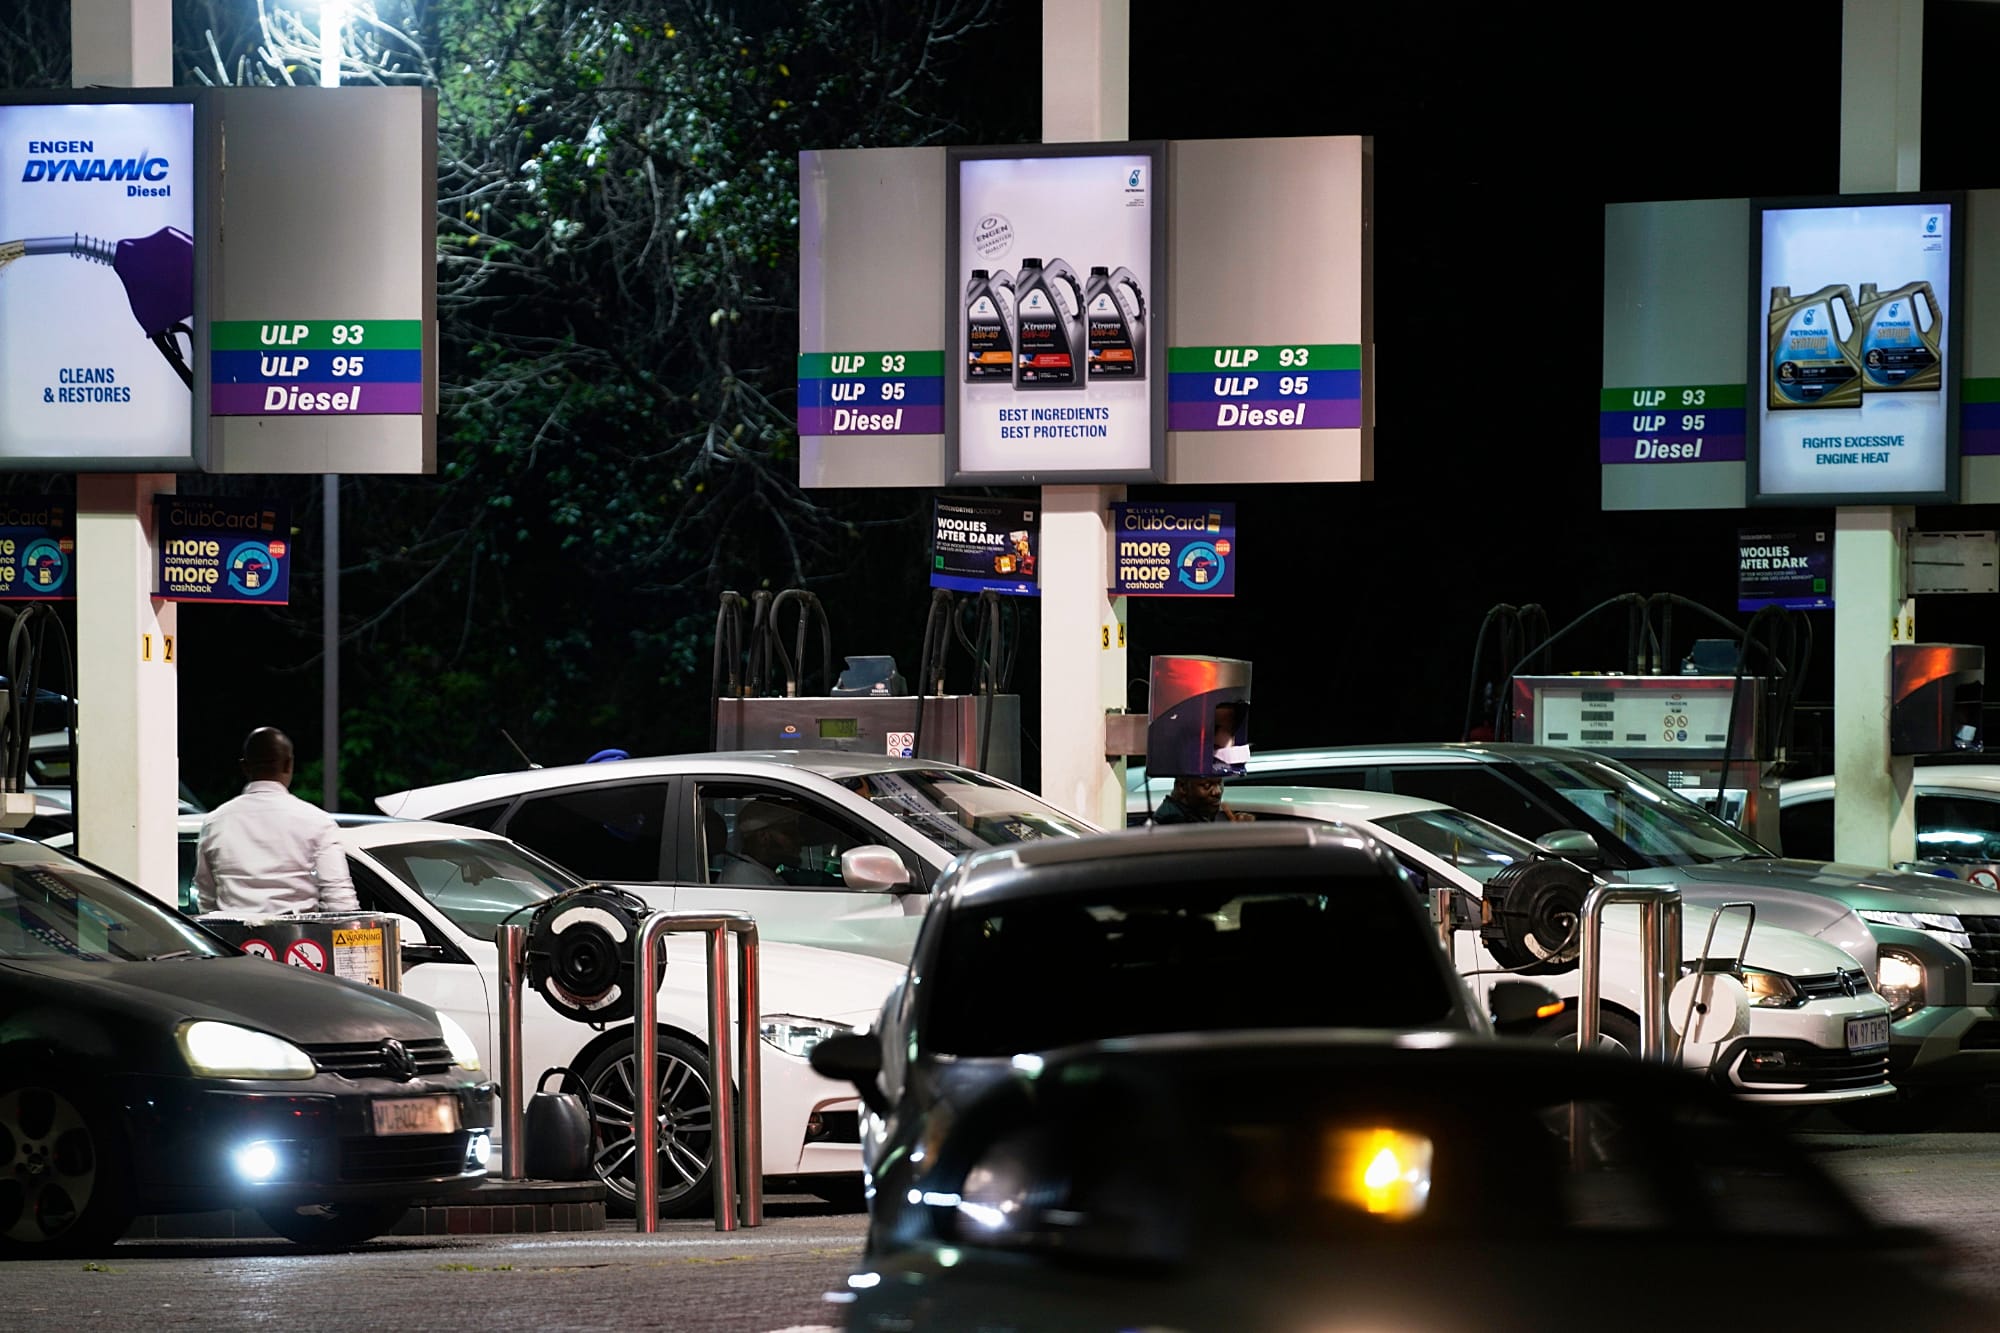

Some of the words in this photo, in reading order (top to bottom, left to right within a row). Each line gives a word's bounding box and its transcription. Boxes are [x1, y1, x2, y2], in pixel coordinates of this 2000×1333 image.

[29, 141, 93, 153] ENGEN
[22, 156, 170, 183] DYNAMIC
[127, 185, 171, 197] Diesel
[976, 224, 1008, 242] ENGEN
[972, 324, 1001, 332] Xtreme
[1022, 322, 1057, 331] Xtreme
[1091, 322, 1121, 331] Xtreme
[260, 325, 309, 346] ULP
[332, 325, 364, 345] 93
[831, 356, 865, 374] ULP
[881, 355, 905, 372] 93
[1214, 349, 1259, 368] ULP
[1279, 348, 1309, 367] 93
[260, 357, 309, 378] ULP
[331, 357, 364, 377] 95
[60, 368, 115, 384] CLEANS
[831, 383, 865, 401] ULP
[881, 383, 905, 400] 95
[1214, 377, 1259, 396] ULP
[1279, 377, 1309, 395] 95
[43, 388, 55, 402] &
[58, 388, 131, 402] RESTORES
[264, 386, 361, 411] Diesel
[1633, 390, 1666, 407] ULP
[1682, 389, 1706, 406] 93
[833, 409, 903, 431] Diesel
[999, 409, 1028, 422] BEST
[1032, 407, 1109, 421] INGREDIENTS
[1217, 403, 1306, 427] Diesel
[1632, 415, 1666, 432] ULP
[1681, 415, 1705, 431] 95
[1001, 426, 1030, 439] BEST
[1034, 425, 1107, 438] PROTECTION
[1634, 438, 1703, 459] Diesel
[1802, 436, 1842, 448] FIGHTS
[1844, 435, 1905, 447] EXCESSIVE
[1816, 453, 1859, 465] ENGINE
[1861, 452, 1890, 463] HEAT
[170, 509, 258, 528] ClubCard
[937, 517, 987, 533] WOOLIES
[1124, 515, 1205, 531] ClubCard
[936, 529, 966, 543] AFTER
[969, 532, 1005, 546] DARK
[165, 540, 219, 557] more
[1120, 542, 1171, 557] more
[1740, 546, 1790, 558] WOOLIES
[165, 557, 219, 565] convenience
[1120, 557, 1170, 565] convenience
[1740, 558, 1770, 570] AFTER
[1773, 557, 1808, 569] DARK
[164, 567, 219, 584] more
[1120, 566, 1171, 581] more
[170, 584, 212, 592] cashback
[1125, 581, 1164, 589] cashback
[1103, 627, 1109, 647] 3
[1119, 625, 1125, 645] 4
[1893, 620, 1899, 637] 5
[1907, 620, 1913, 636] 6
[144, 637, 150, 659] 1
[165, 638, 172, 660] 2
[346, 933, 380, 941] WARNING
